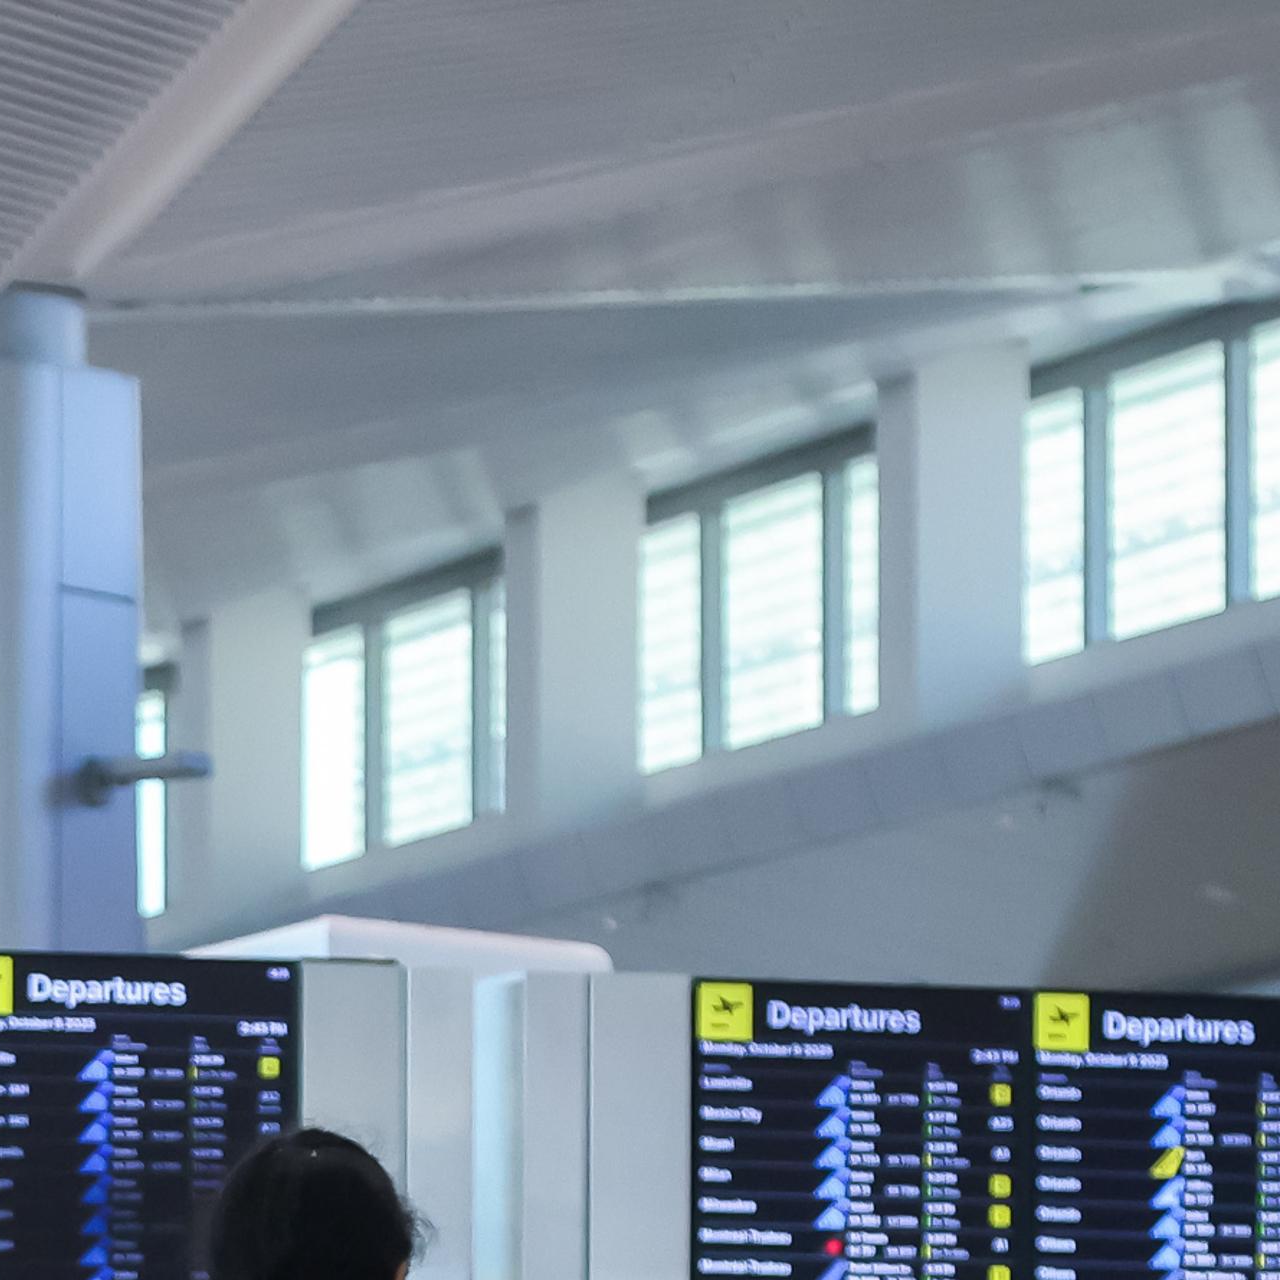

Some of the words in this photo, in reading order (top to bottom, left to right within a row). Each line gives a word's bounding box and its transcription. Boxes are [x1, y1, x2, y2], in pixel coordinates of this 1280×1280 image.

[26, 972, 188, 1009] Departures
[766, 1000, 921, 1036] Departures
[1103, 1010, 1255, 1047] Departures
